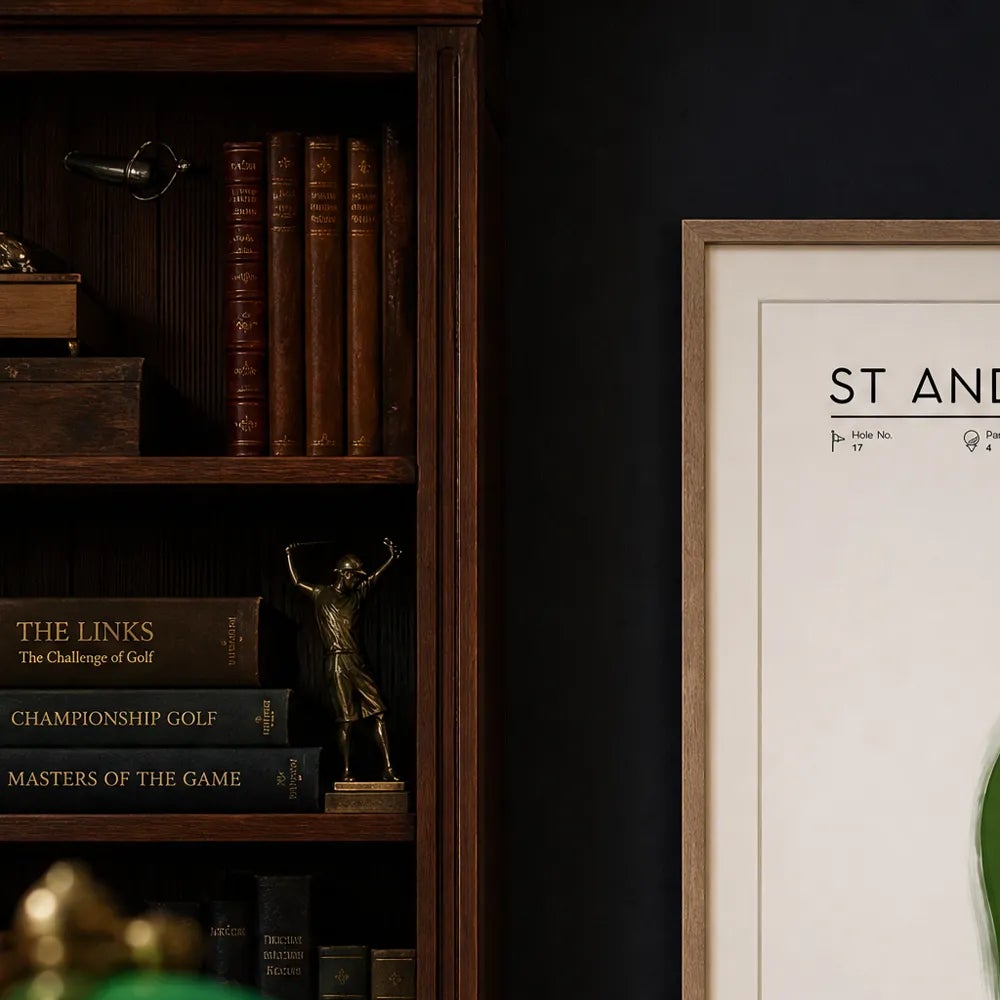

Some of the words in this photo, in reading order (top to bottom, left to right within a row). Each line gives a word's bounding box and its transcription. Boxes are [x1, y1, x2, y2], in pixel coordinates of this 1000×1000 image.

[829, 367, 887, 405] ST
[851, 430, 874, 440] Hole
[876, 430, 893, 440] No.
[852, 443, 863, 452] 17
[985, 443, 992, 452] 4
[16, 621, 70, 642] THE
[77, 621, 154, 642] LINKS
[18, 650, 44, 664] The
[46, 650, 108, 667] Challenge
[110, 650, 125, 663] of
[126, 650, 155, 664] Golf
[11, 710, 161, 726] CHAMPIONSHIP
[167, 710, 218, 726] GOLF
[7, 770, 98, 787] MASTERS
[104, 770, 130, 787] OF
[136, 771, 177, 787] THE
[182, 770, 241, 787] GAME
